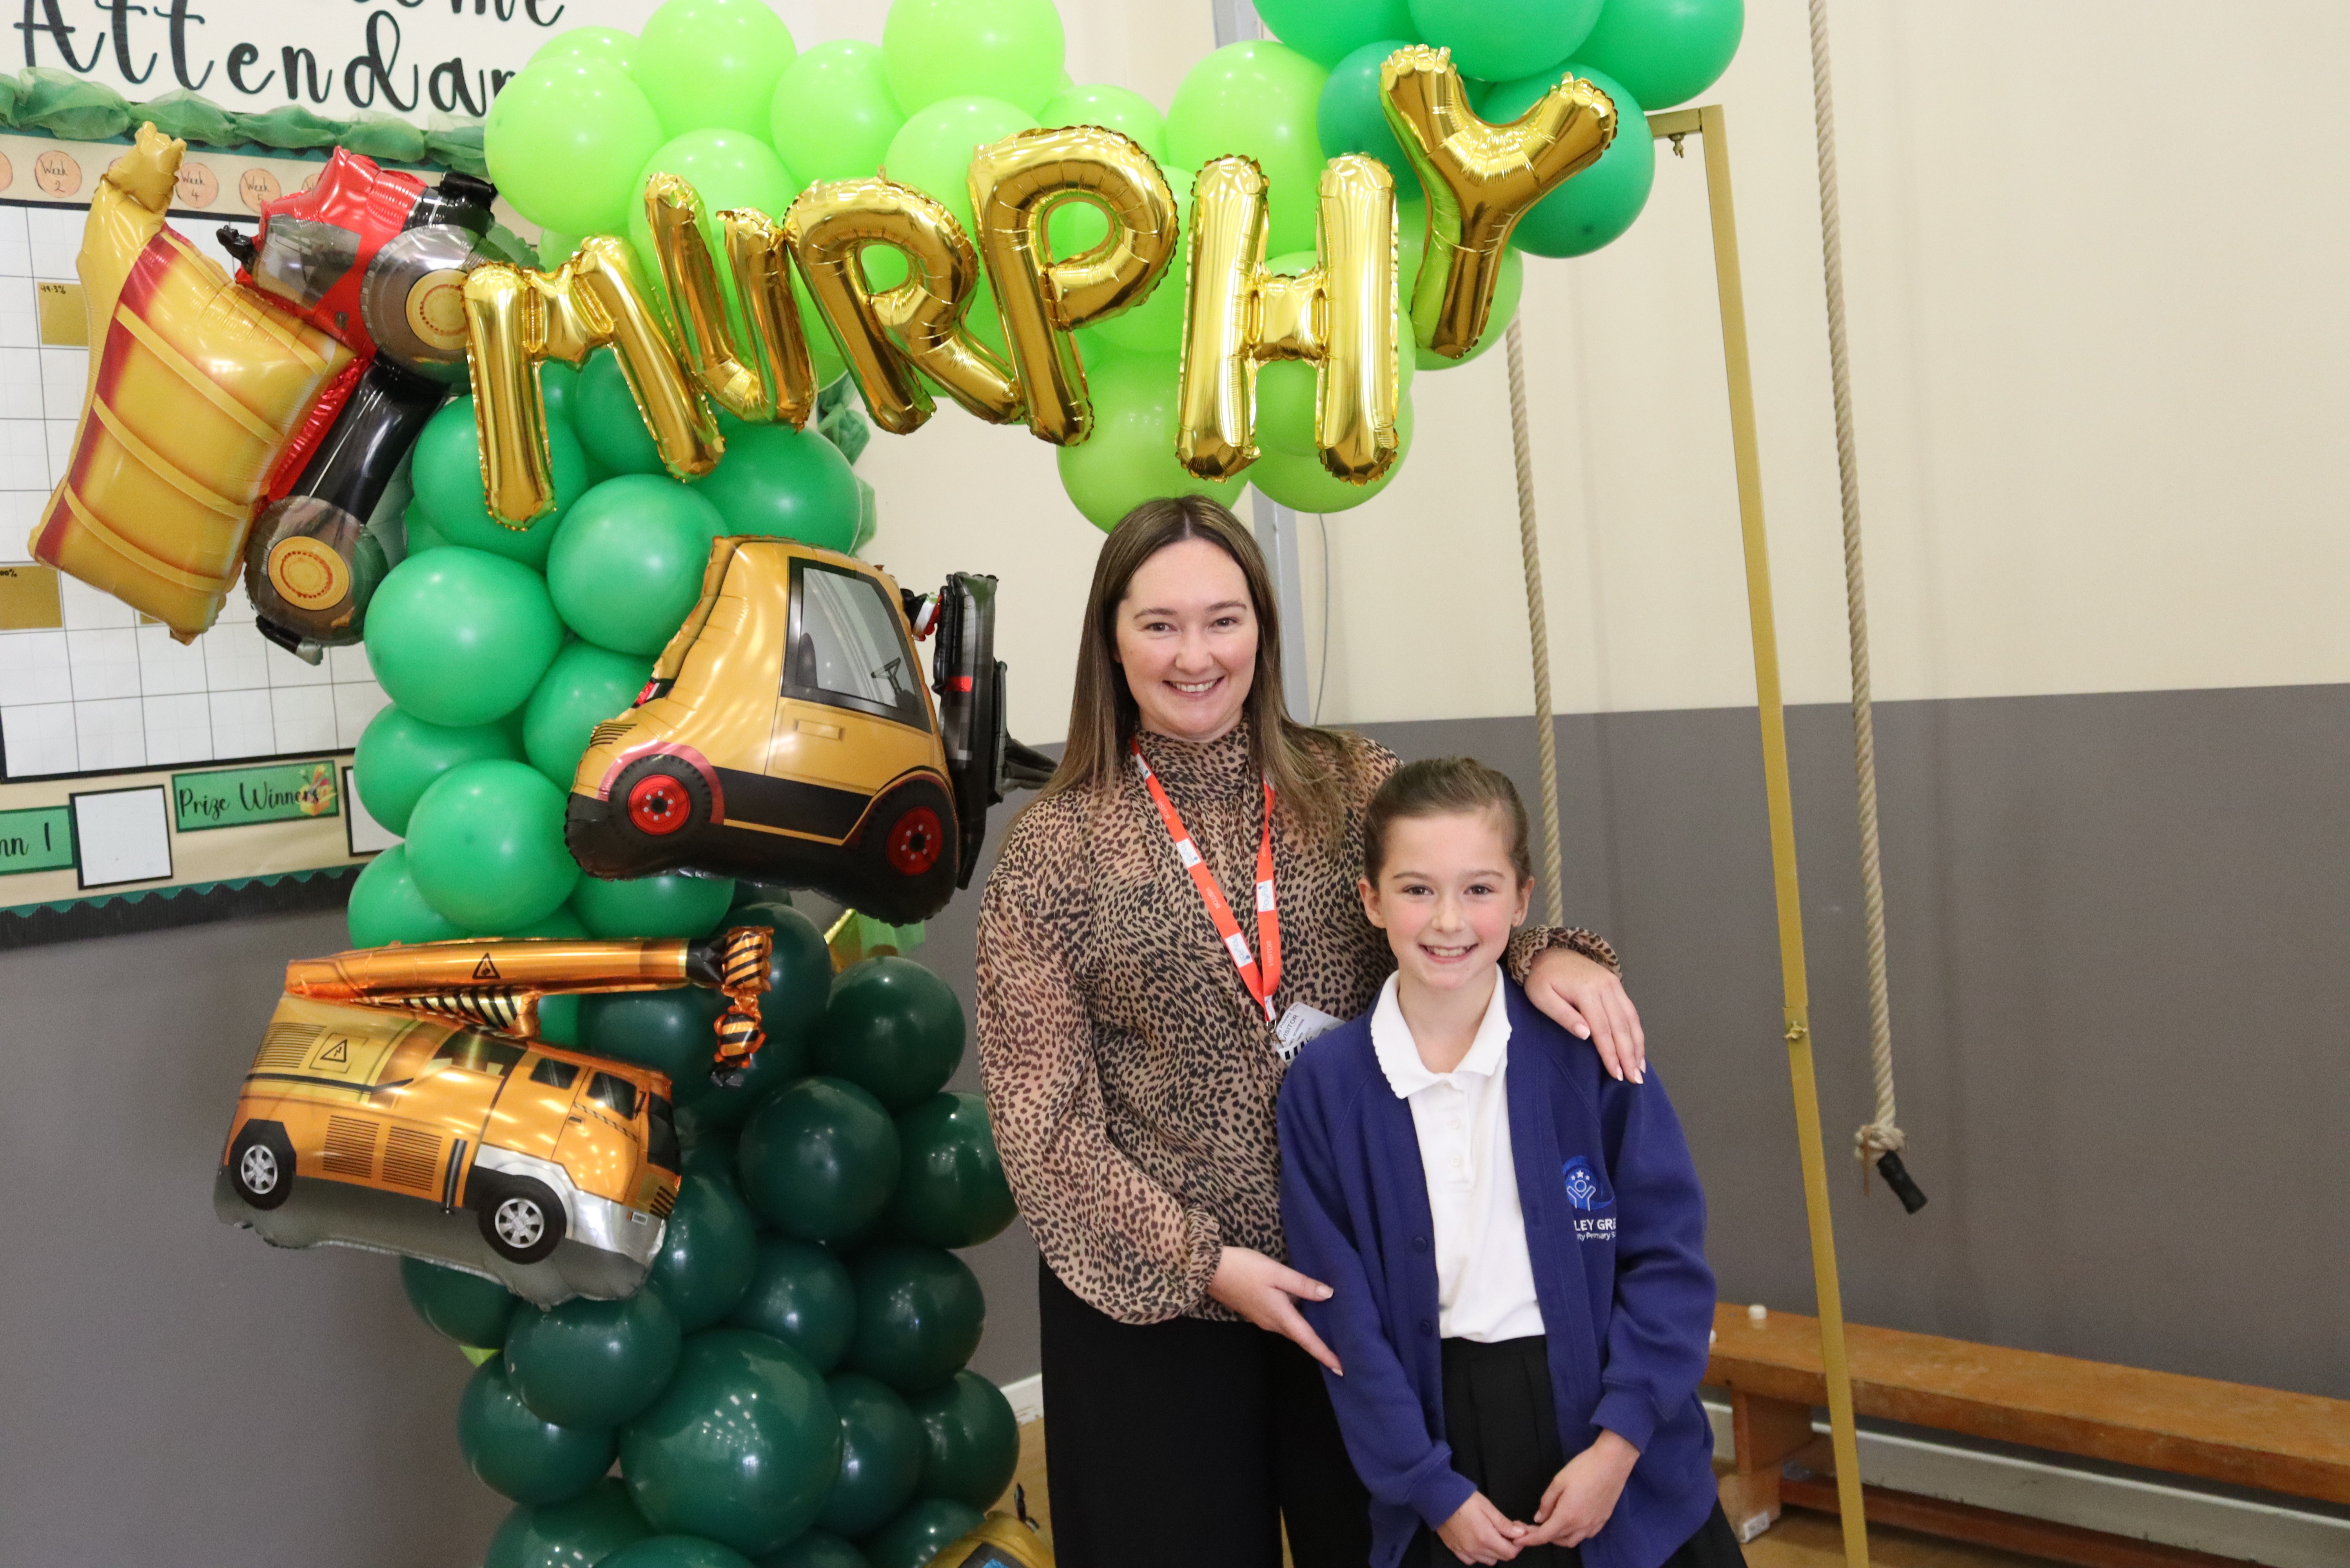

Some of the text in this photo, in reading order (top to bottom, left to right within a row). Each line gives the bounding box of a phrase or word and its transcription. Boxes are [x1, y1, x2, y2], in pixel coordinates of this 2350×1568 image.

[40, 159, 69, 176] Week
[180, 170, 205, 185] Week
[244, 175, 270, 192] Week
[54, 180, 65, 193] 2
[191, 188, 200, 201] 4
[463, 43, 1619, 532] MURPHY
[179, 788, 231, 821] Prize
[1156, 798, 1170, 820] VISITOR
[1205, 886, 1221, 909] VISITOR
[1586, 1232, 1610, 1241] Primary
